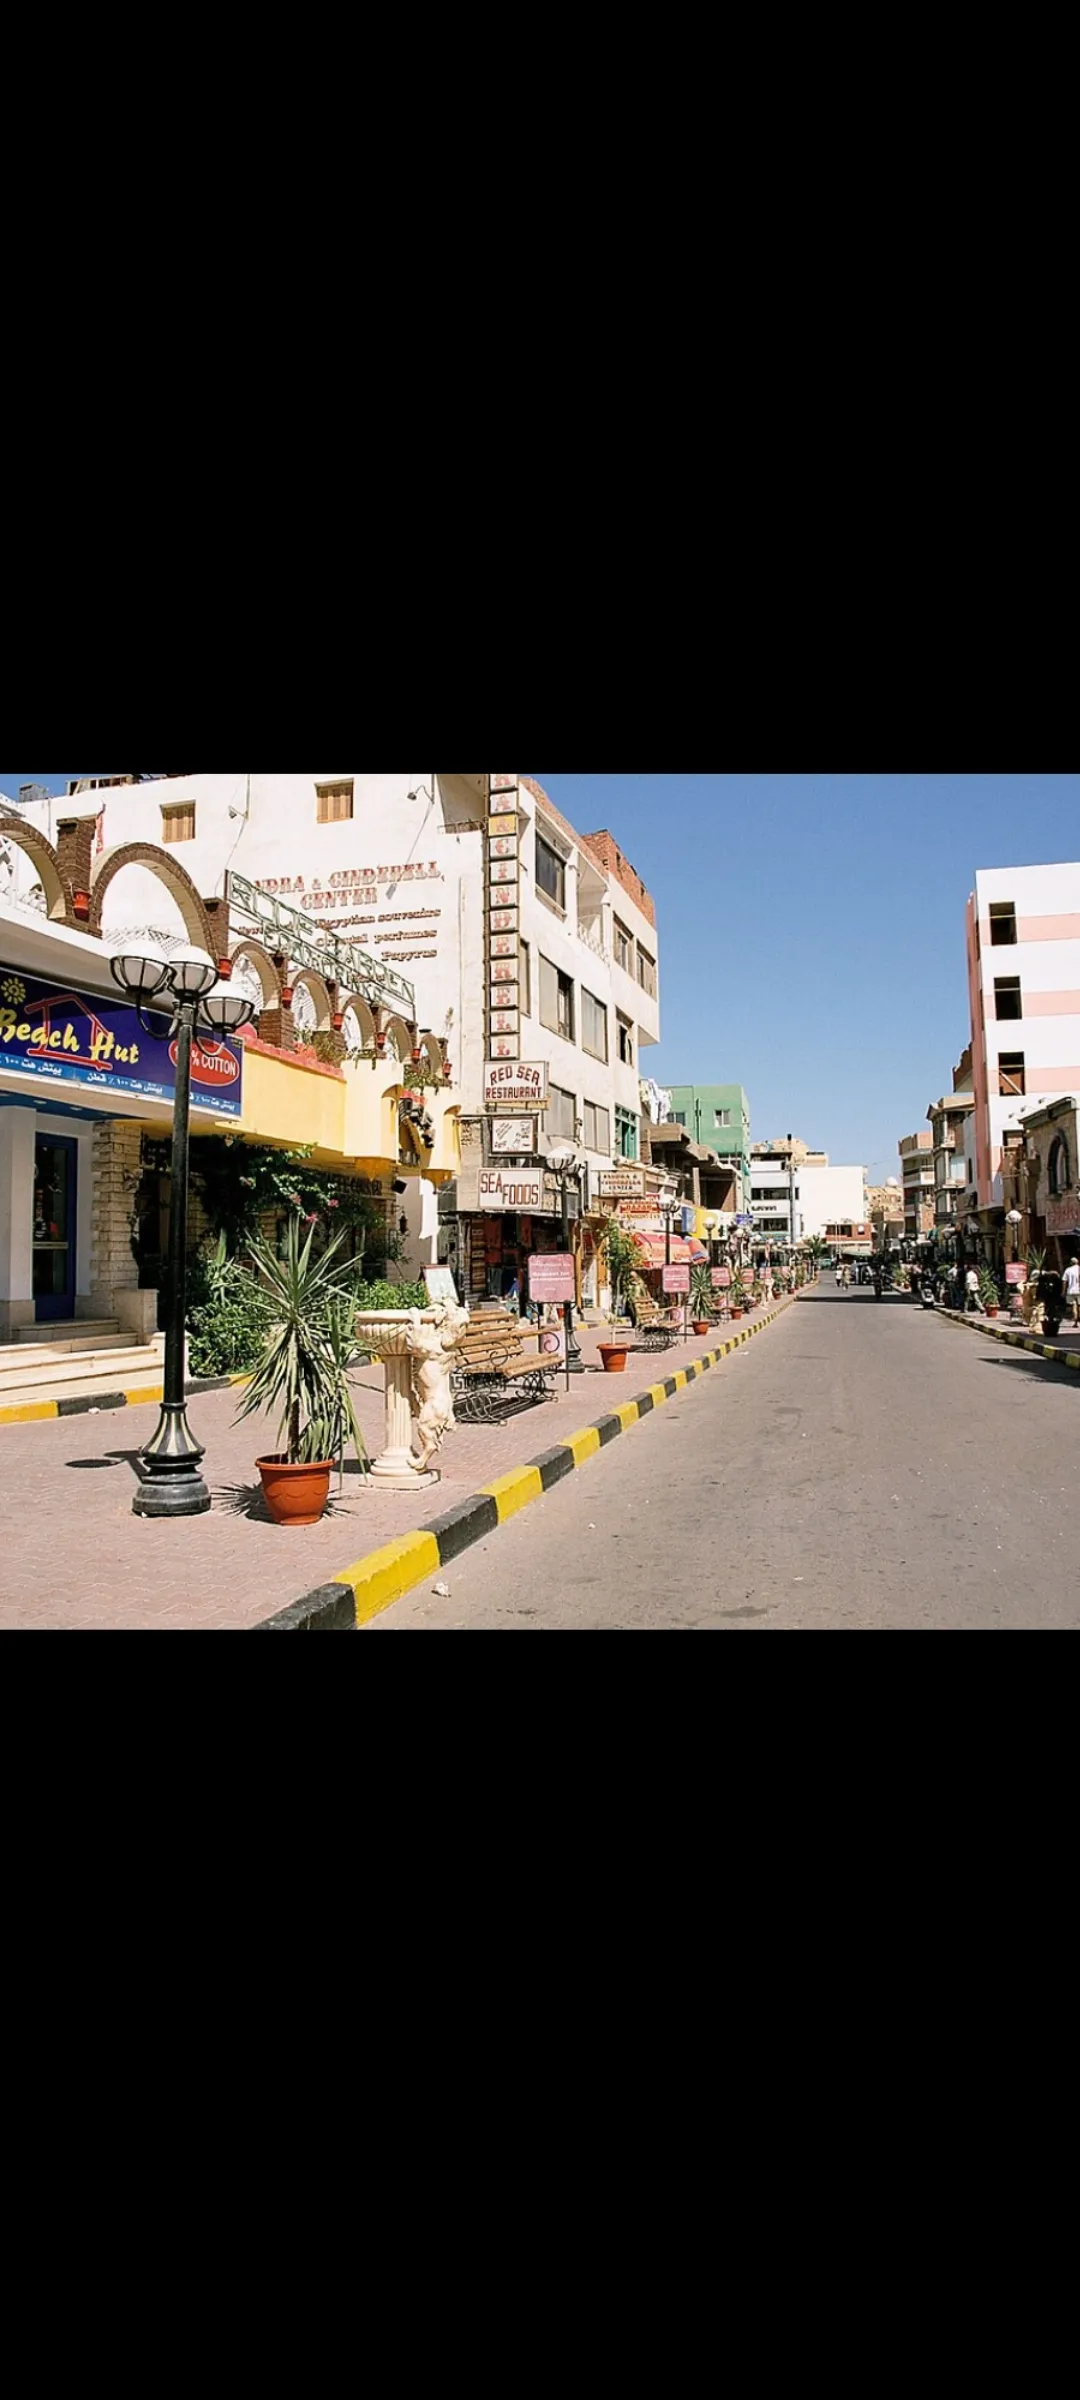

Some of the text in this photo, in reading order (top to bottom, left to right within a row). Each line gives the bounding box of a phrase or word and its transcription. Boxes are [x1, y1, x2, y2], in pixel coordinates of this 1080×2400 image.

[254, 876, 305, 895] NDRA
[301, 887, 377, 910] CENTER
[0, 1007, 140, 1064] Beach Hut
[201, 1054, 236, 1076] COTTON
[490, 1065, 540, 1086] RED SEA
[485, 1086, 542, 1099] RESTAURANT
[480, 1172, 539, 1205] SEA FOODS
